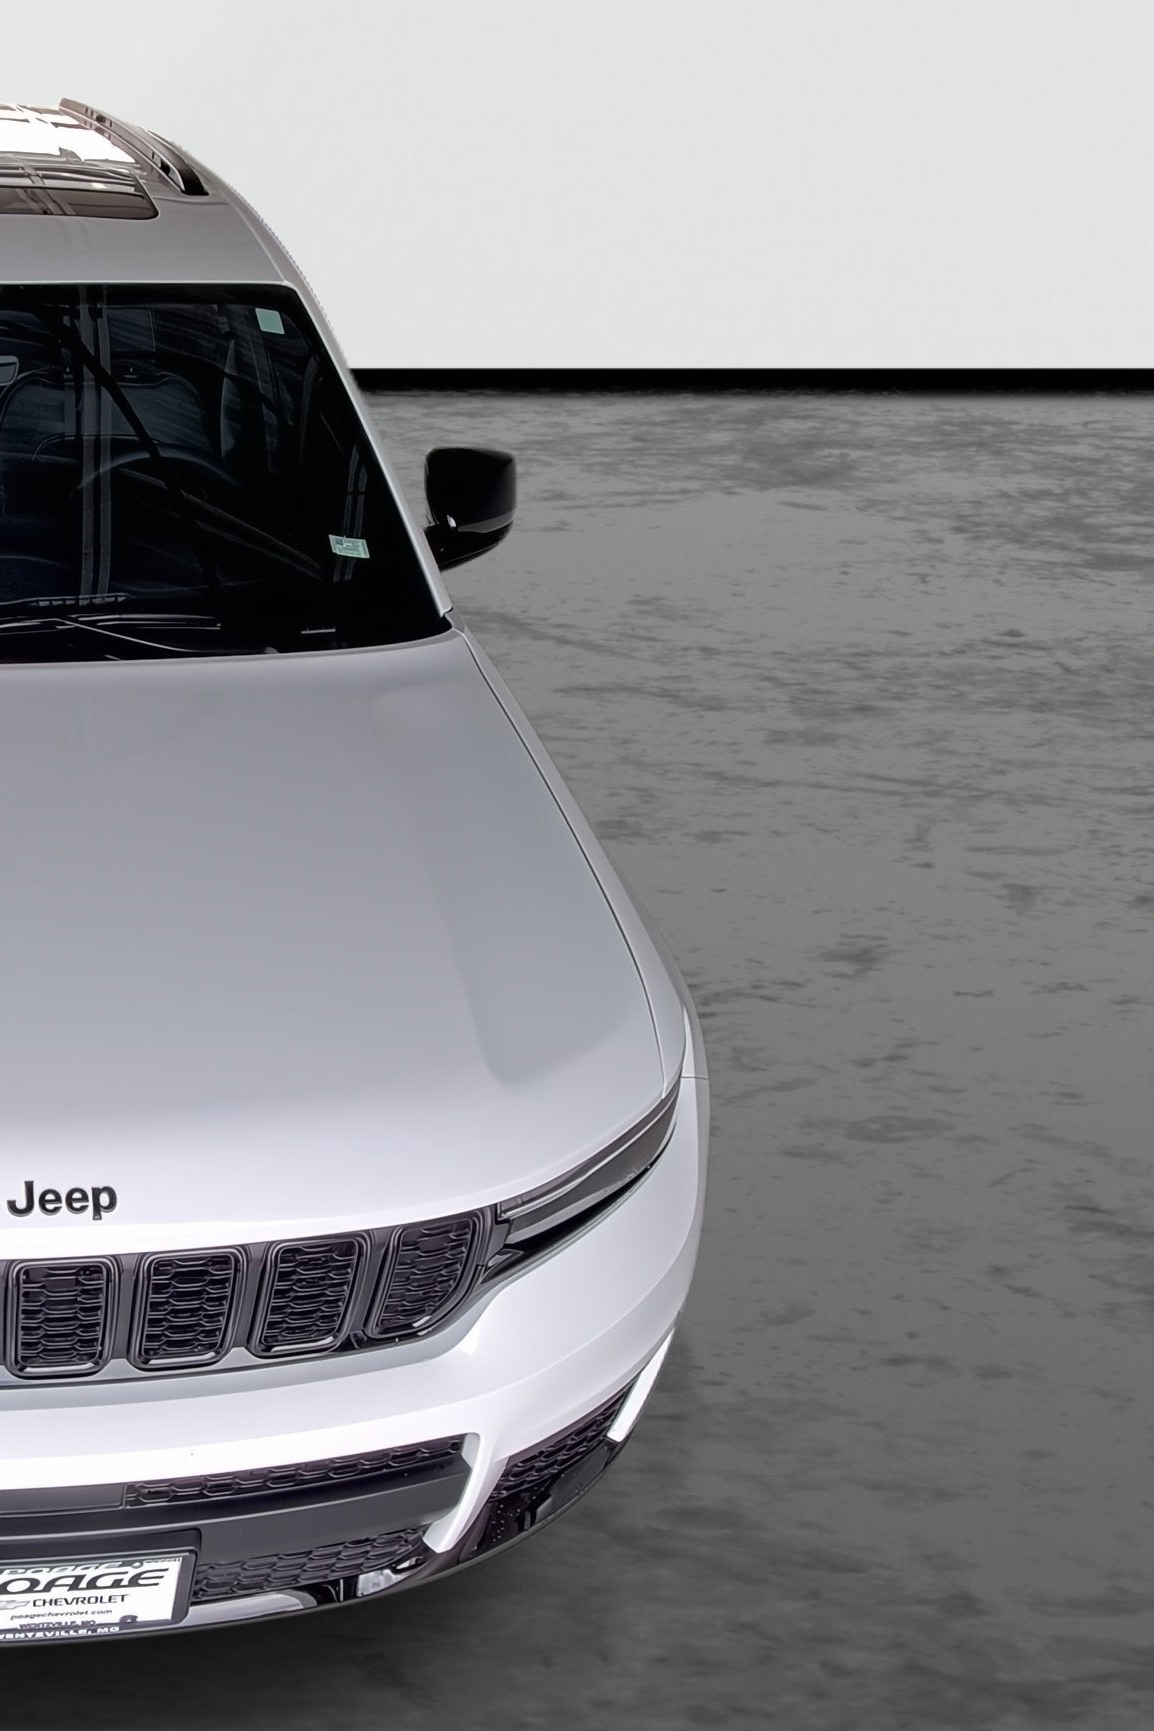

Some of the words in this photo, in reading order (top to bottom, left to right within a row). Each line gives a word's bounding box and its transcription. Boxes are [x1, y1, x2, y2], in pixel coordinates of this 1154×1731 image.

[6, 1180, 118, 1221] Jeep
[32, 1594, 130, 1608] CHEVROLET
[10, 1609, 113, 1621] poagechevrolet.com
[96, 1626, 120, 1634] MO
